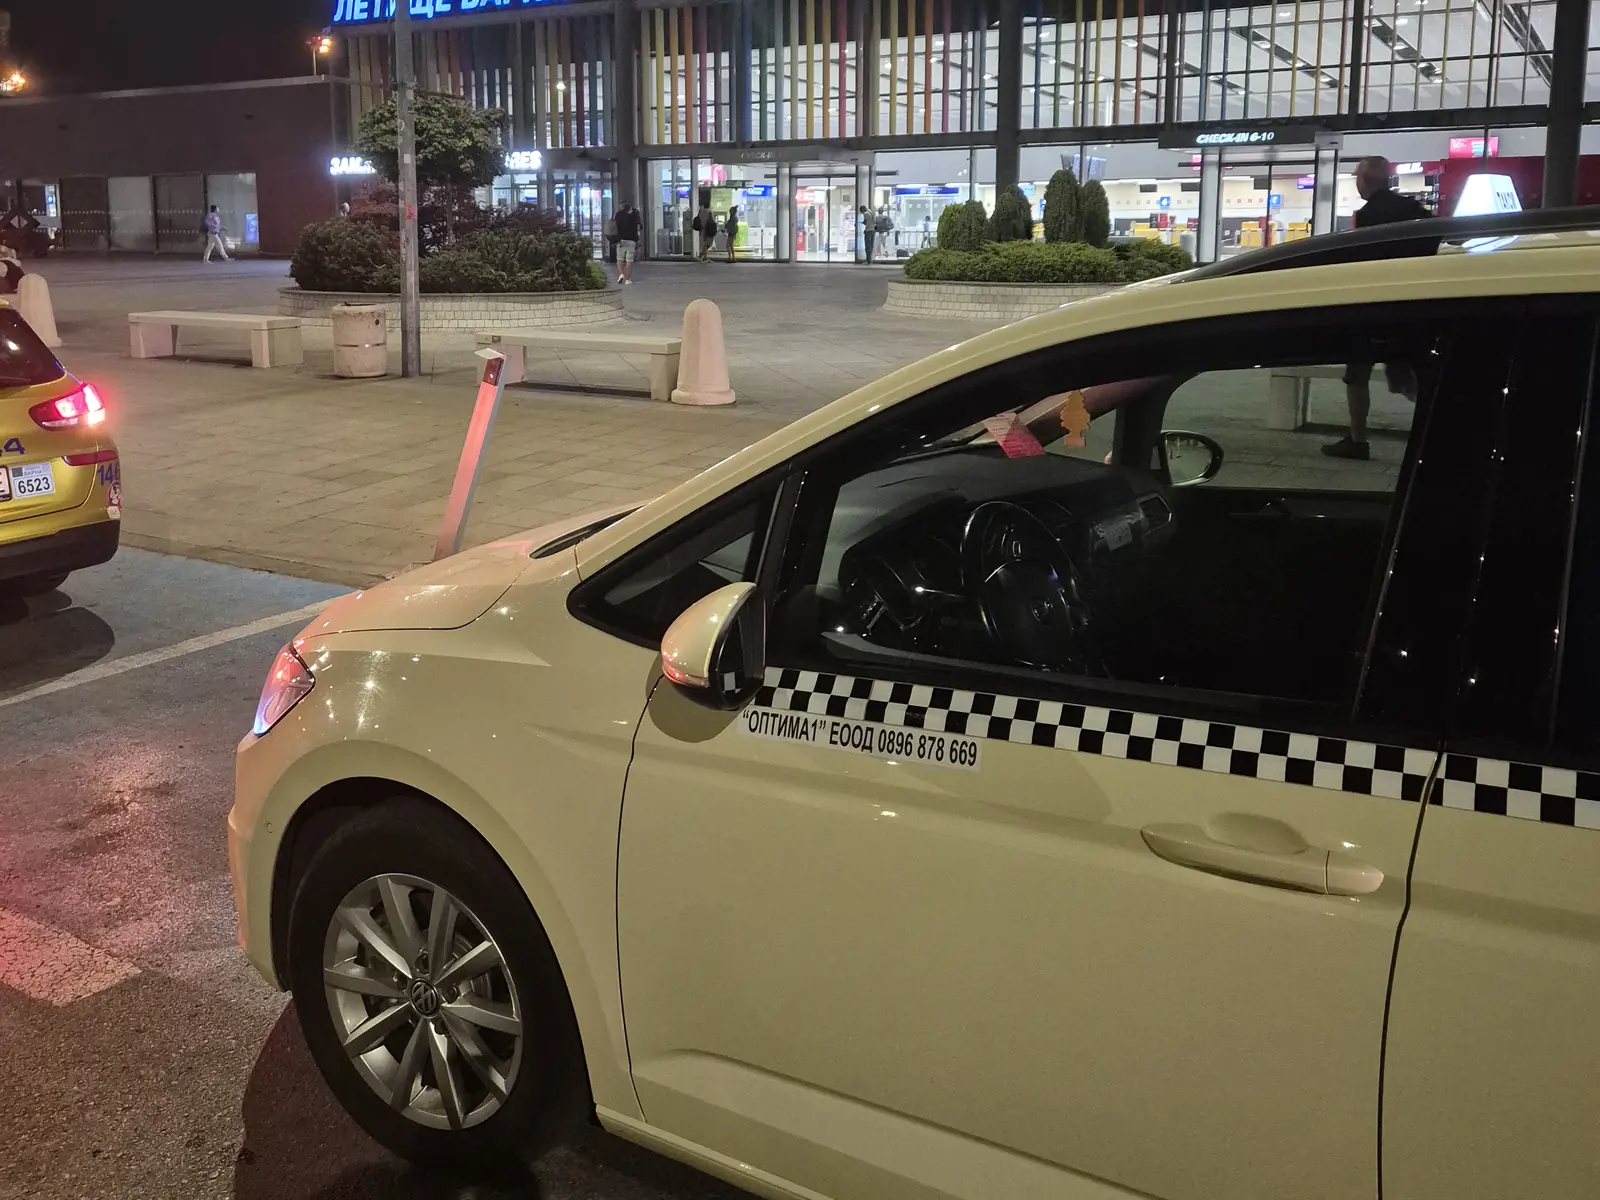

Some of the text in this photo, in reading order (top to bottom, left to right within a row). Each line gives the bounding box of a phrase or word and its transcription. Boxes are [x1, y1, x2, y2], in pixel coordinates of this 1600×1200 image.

[1196, 131, 1275, 144] CHECK-IN 6-10
[18, 476, 51, 495] 6523
[829, 721, 873, 752] ЕООД
[877, 731, 914, 757] 0896
[917, 735, 945, 762] 878
[949, 739, 978, 767] 669
